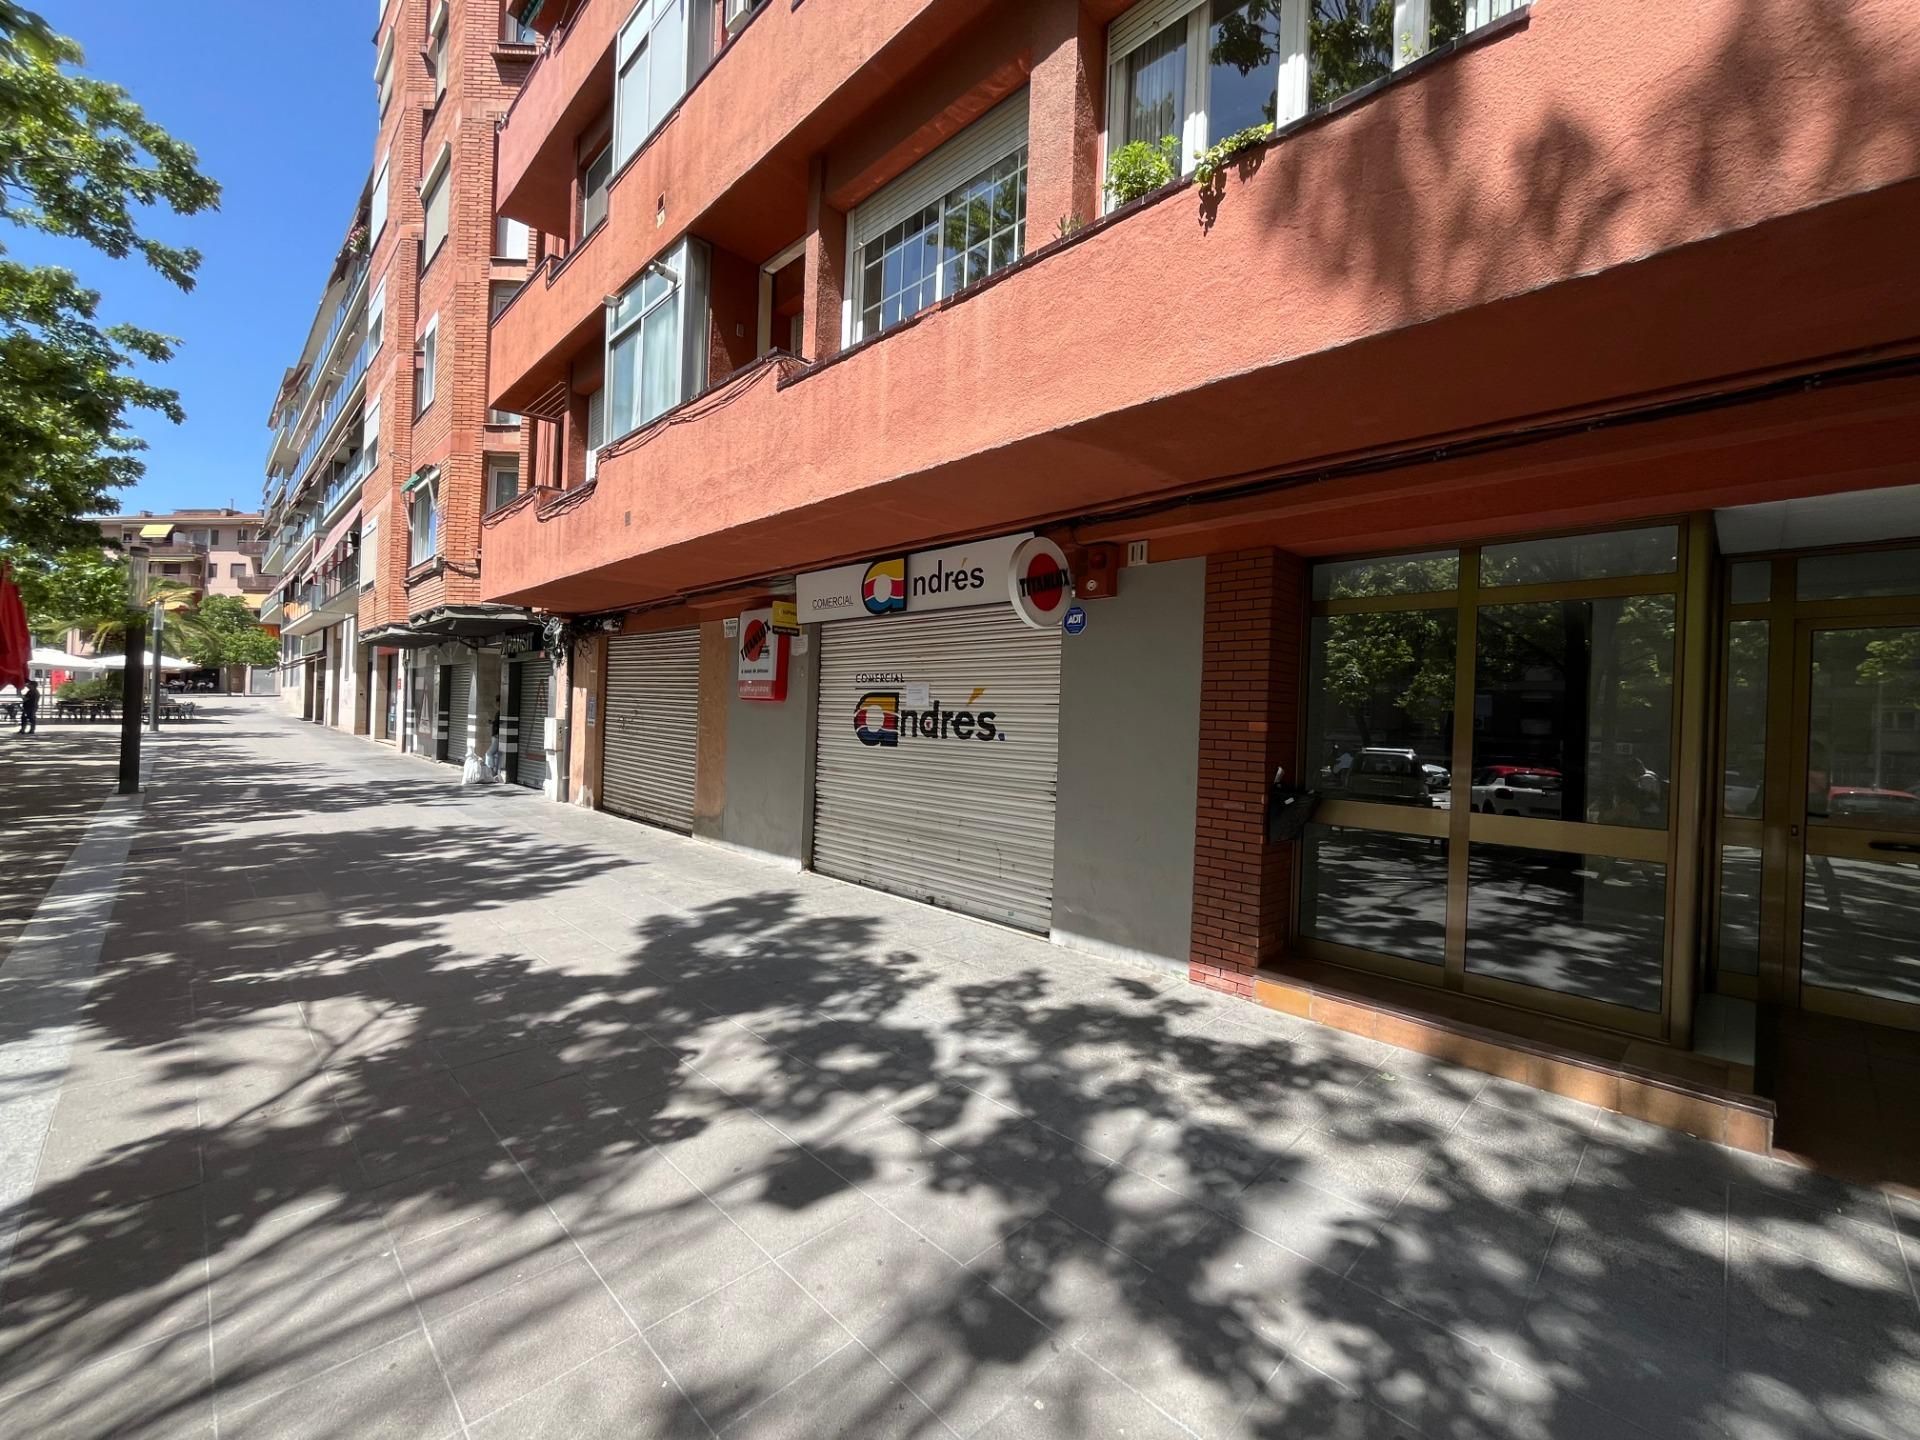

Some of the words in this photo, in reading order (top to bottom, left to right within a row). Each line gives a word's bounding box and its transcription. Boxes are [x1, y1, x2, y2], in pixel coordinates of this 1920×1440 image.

[812, 594, 854, 609] COMERCIAL
[1067, 613, 1084, 626] ADT
[855, 672, 905, 684] COMERCIAL
